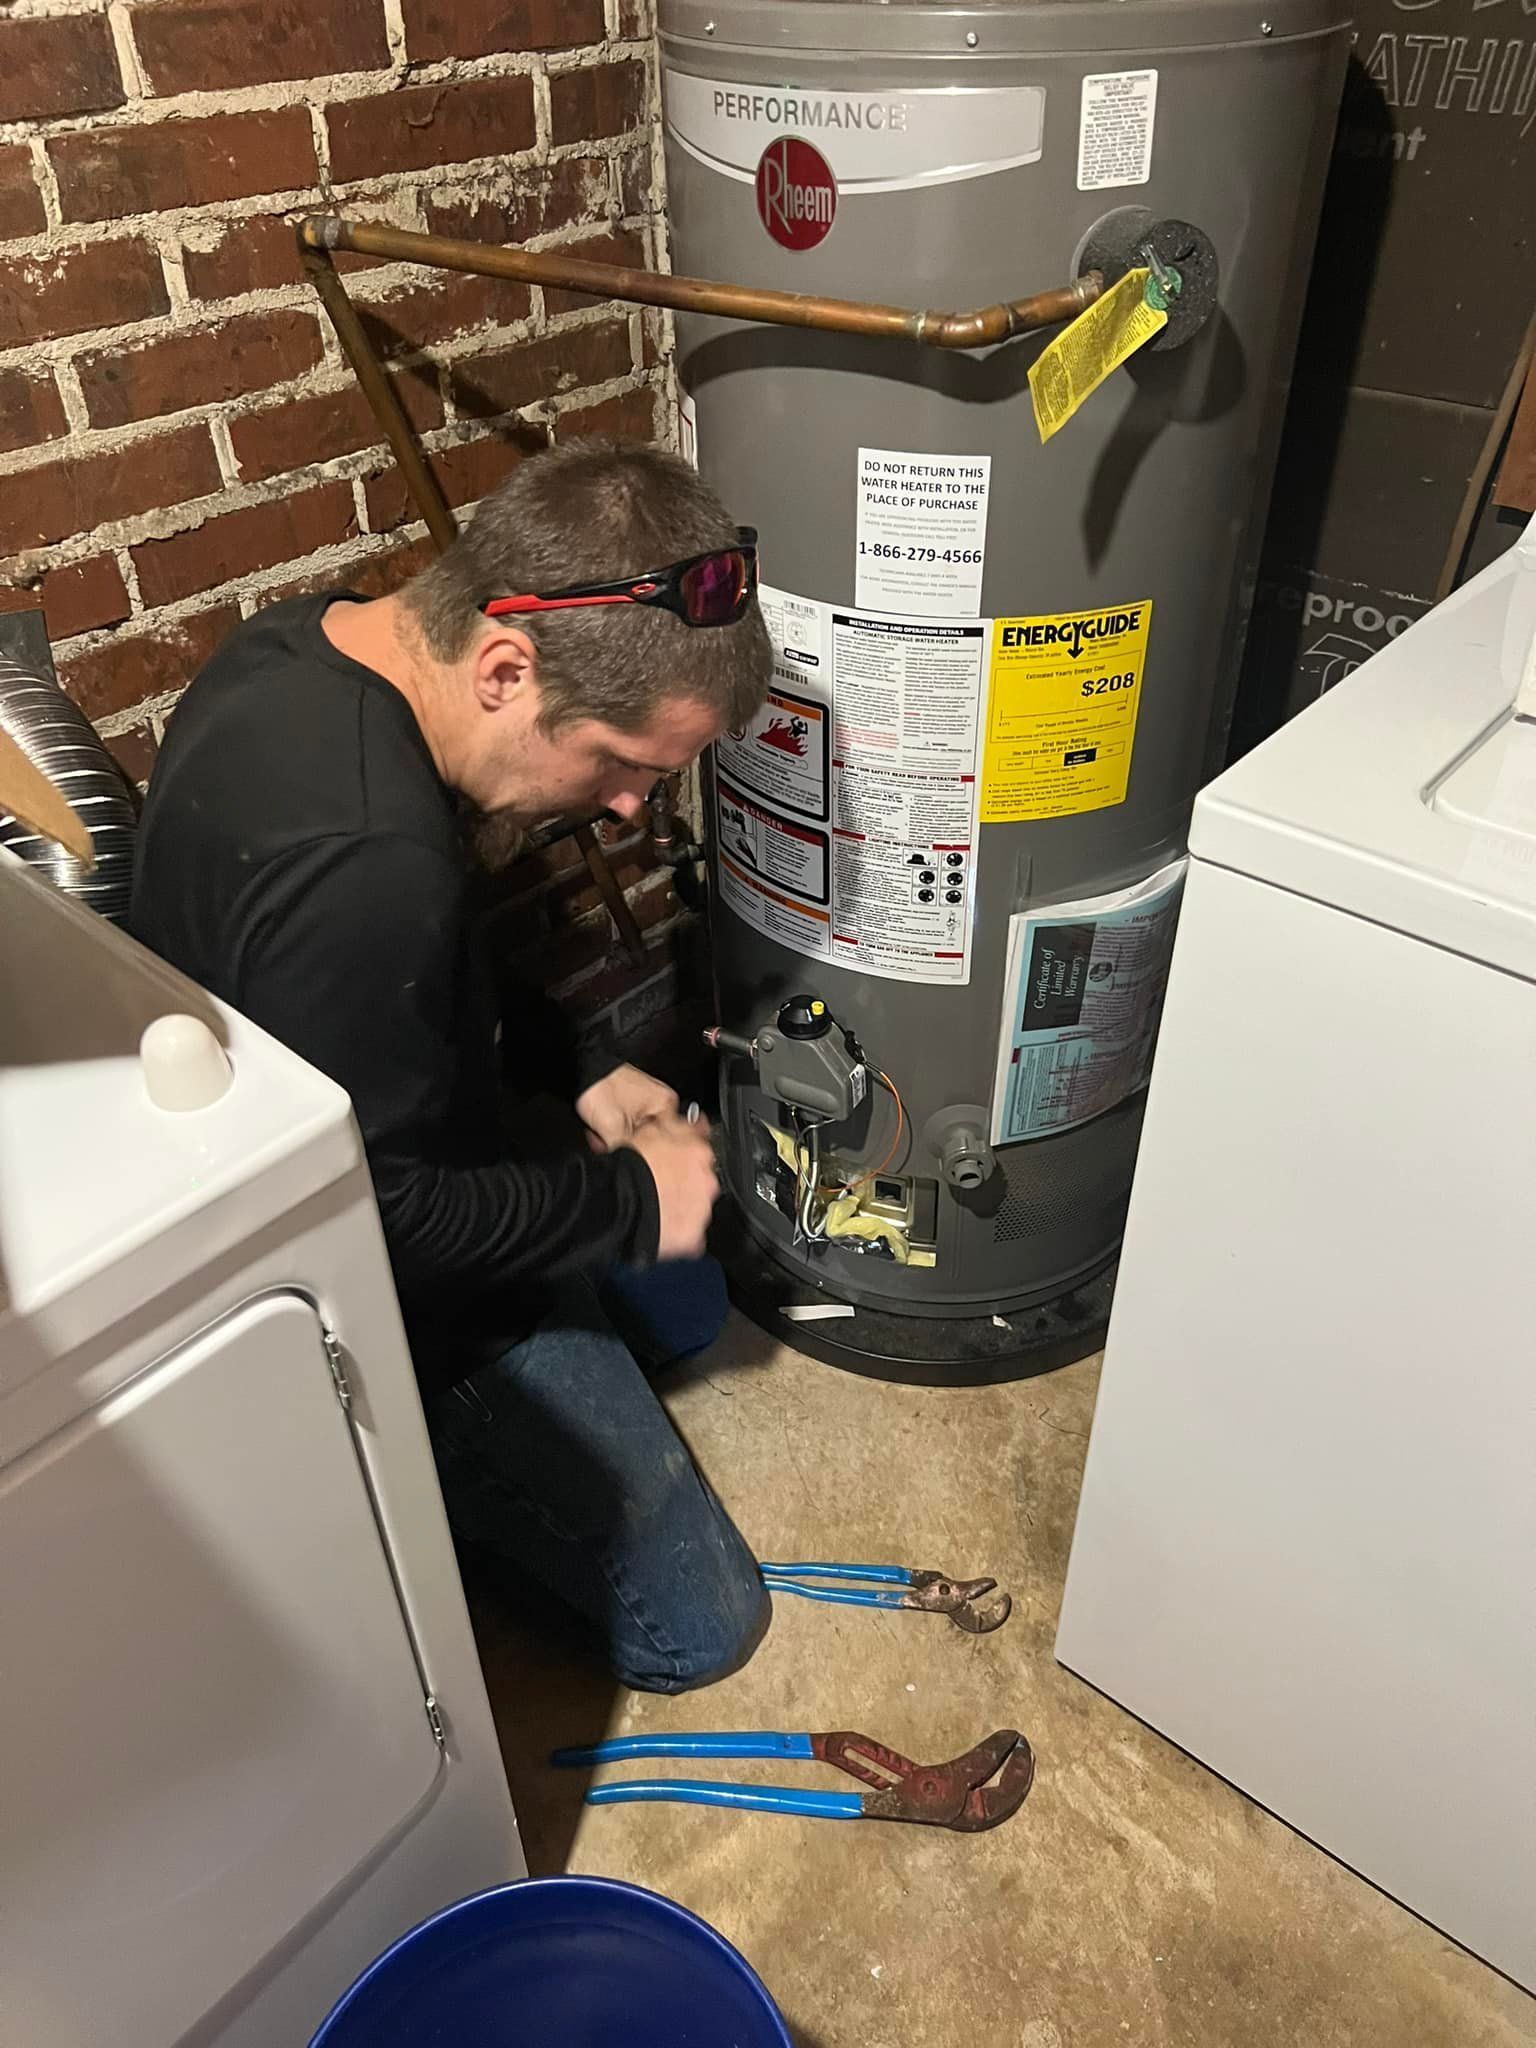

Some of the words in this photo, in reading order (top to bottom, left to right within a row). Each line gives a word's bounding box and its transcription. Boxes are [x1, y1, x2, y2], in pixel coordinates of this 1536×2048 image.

[714, 90, 907, 132] PERFORMANCE
[763, 140, 832, 234] Rheem
[864, 460, 880, 471] DO
[883, 463, 906, 474] NOT
[910, 466, 955, 478] RETURN
[958, 467, 984, 478] THIS
[861, 476, 897, 490] WATER
[900, 481, 942, 493] HEATER
[945, 484, 961, 494] TO
[964, 484, 985, 494] THE
[866, 493, 898, 506] PLACE
[901, 497, 916, 507] OF
[919, 498, 978, 510] PURCHASE
[859, 541, 982, 563] 1-866-279-4566
[849, 619, 889, 631] INSTALLATION
[904, 626, 938, 635] OPERATION
[853, 630, 885, 640] AUTOMATIC
[887, 635, 913, 643] STORAGE
[1002, 610, 1141, 648] ENERGYGUIDE
[1081, 672, 1135, 697] $208
[1041, 946, 1056, 960] of
[1033, 960, 1051, 1009] Certificate
[1050, 959, 1066, 996] Limited
[1064, 955, 1085, 997] Warranty
